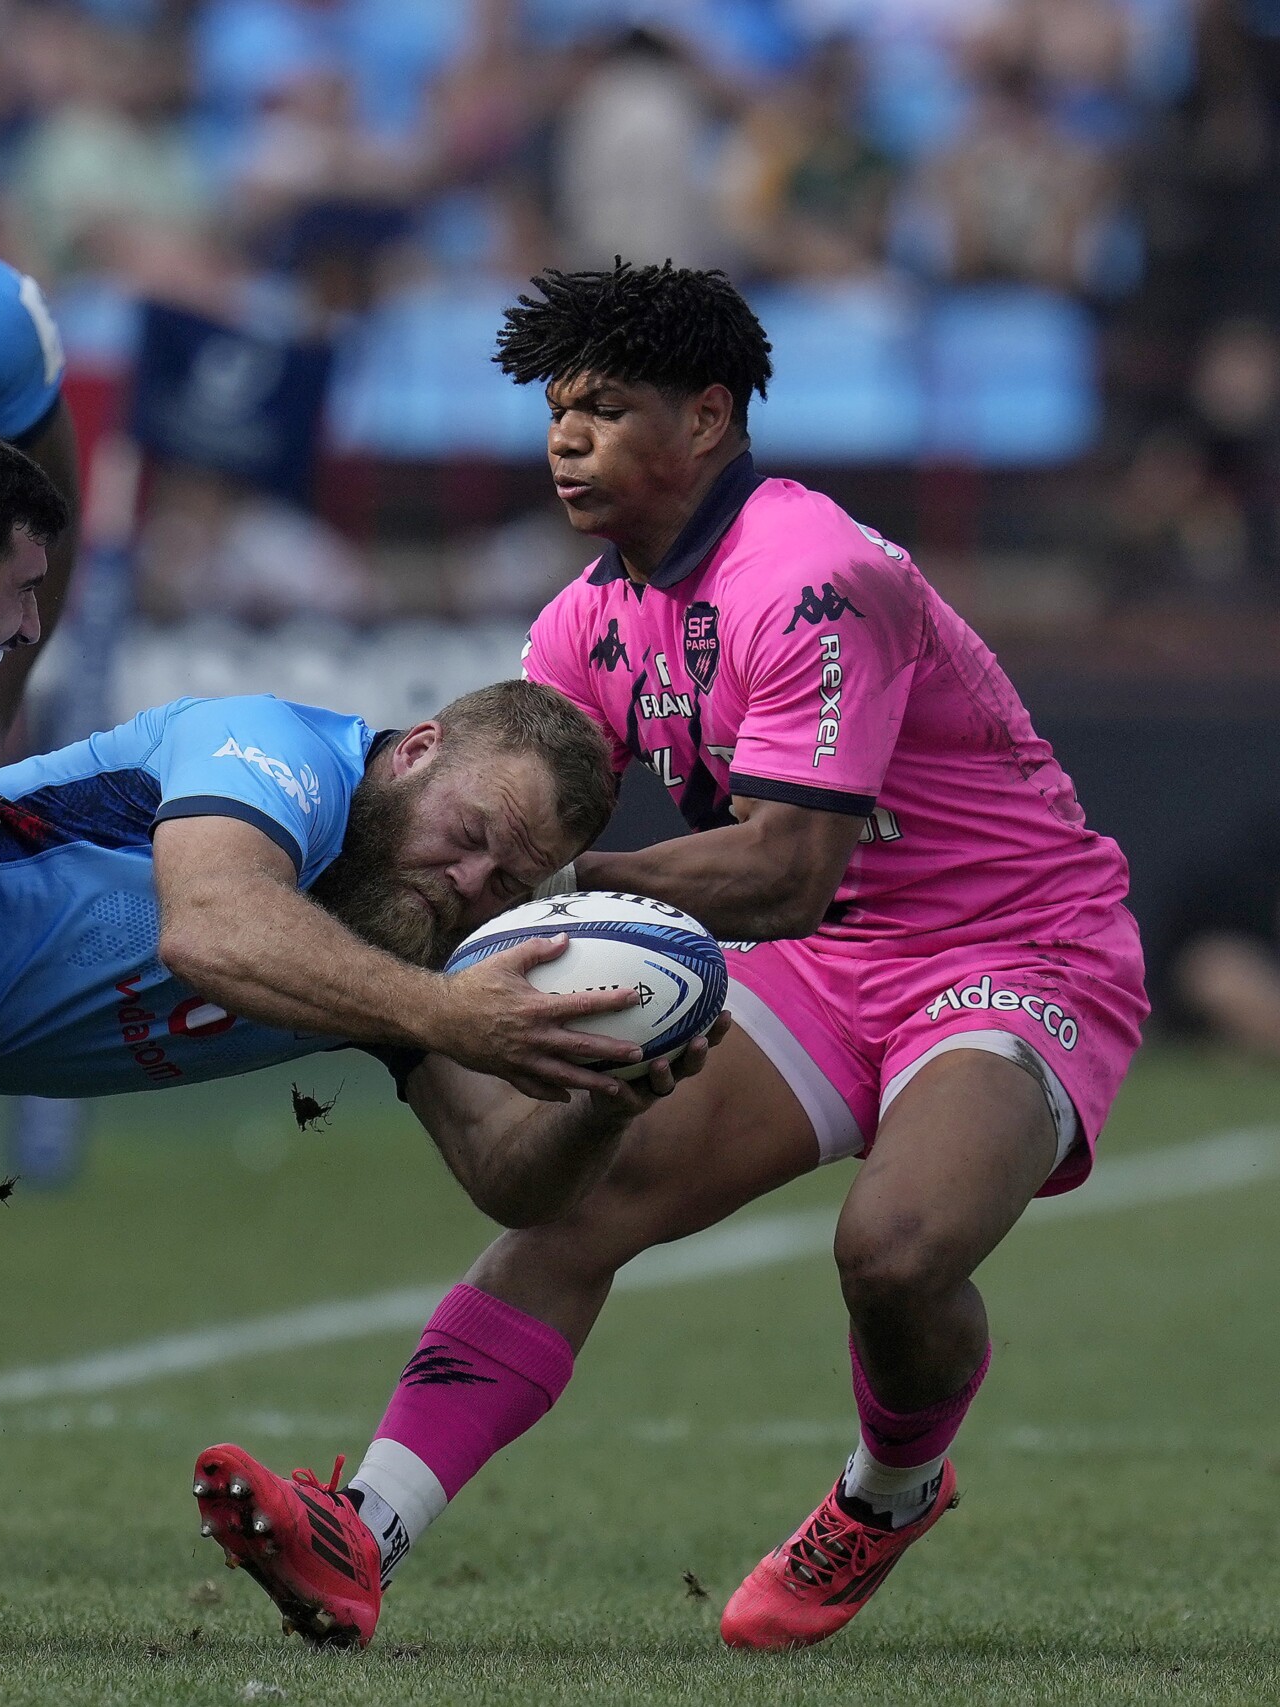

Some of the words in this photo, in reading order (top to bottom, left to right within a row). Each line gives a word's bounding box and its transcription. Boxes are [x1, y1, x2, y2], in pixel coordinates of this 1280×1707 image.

[688, 616, 714, 638] SF
[685, 638, 717, 651] PARIS
[924, 974, 1080, 1052] Adecco
